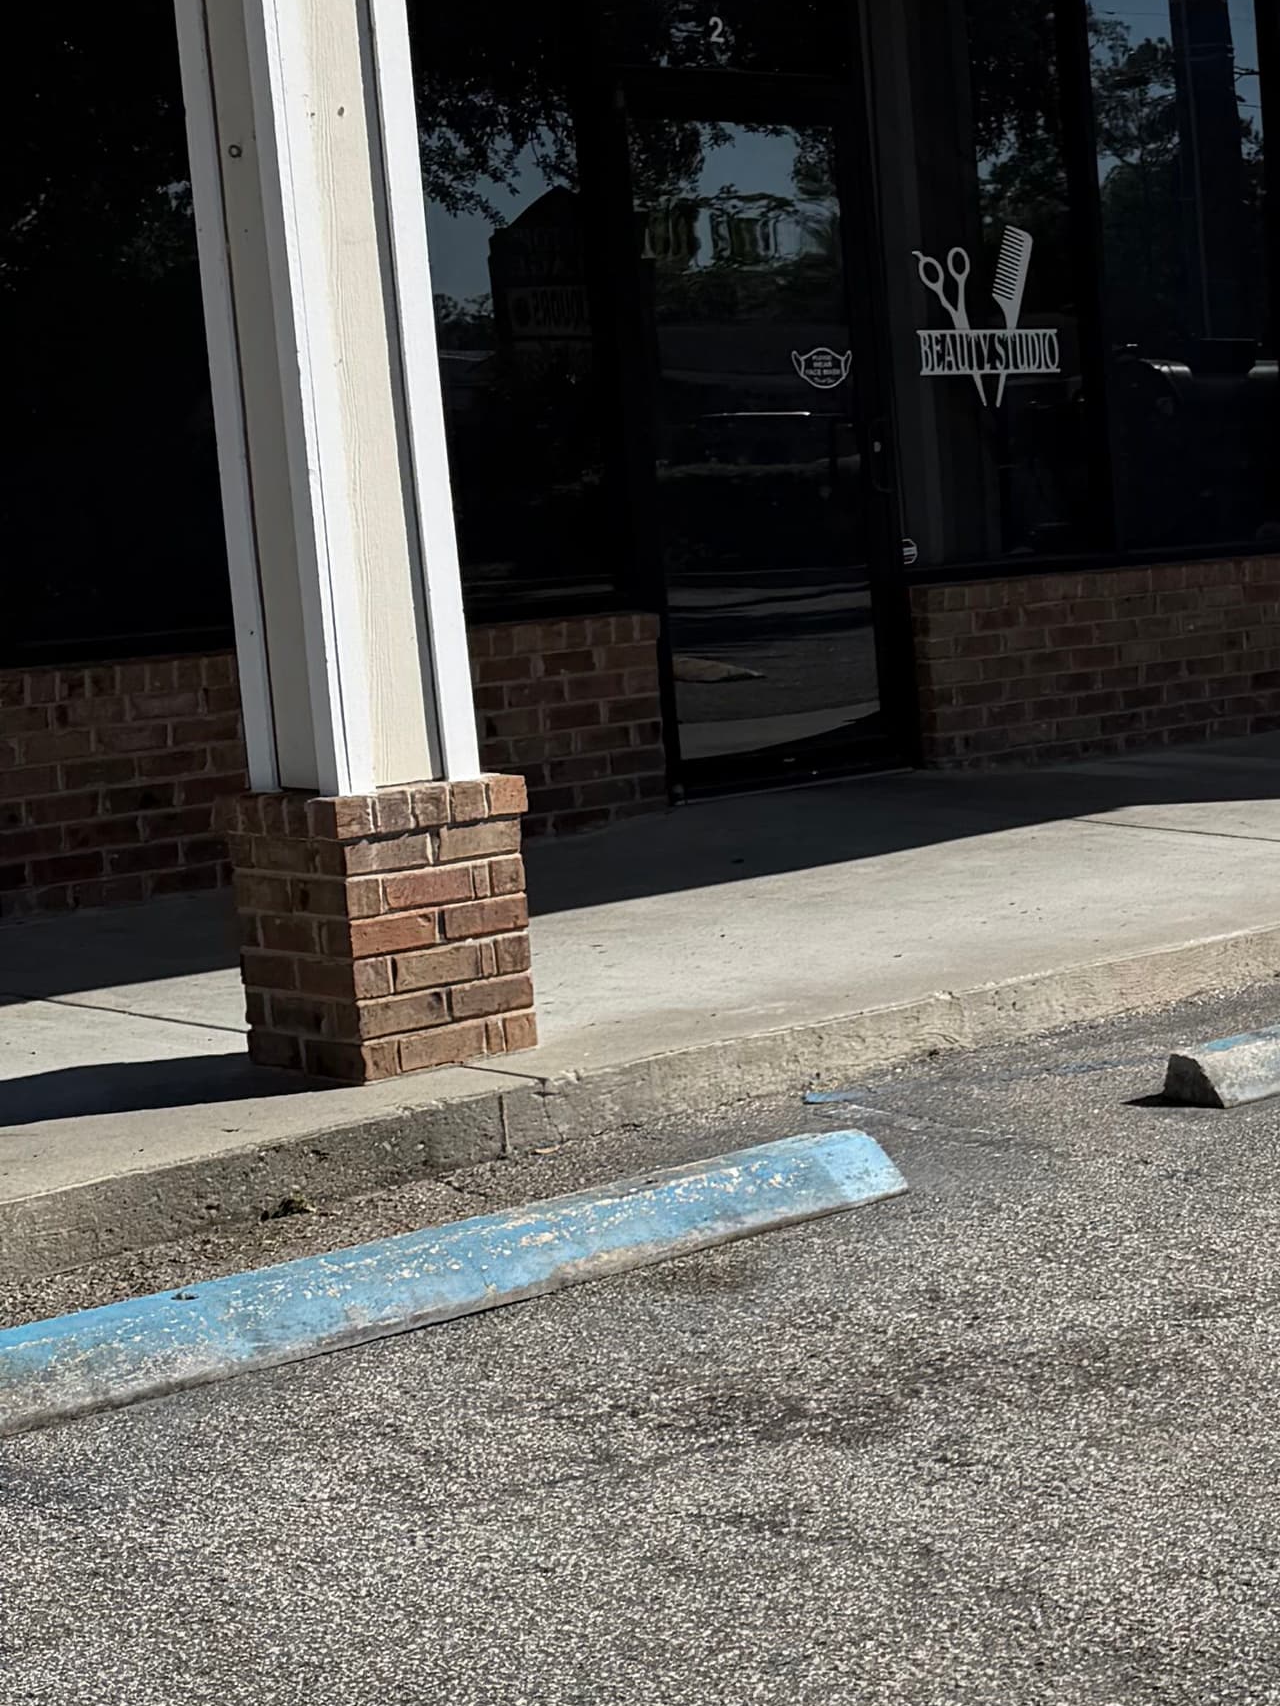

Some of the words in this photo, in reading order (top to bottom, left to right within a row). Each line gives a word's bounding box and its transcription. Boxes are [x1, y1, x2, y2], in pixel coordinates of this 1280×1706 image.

[708, 16, 725, 43] 2
[919, 332, 992, 374] BEAUTY
[992, 332, 1060, 372] STUDIO
